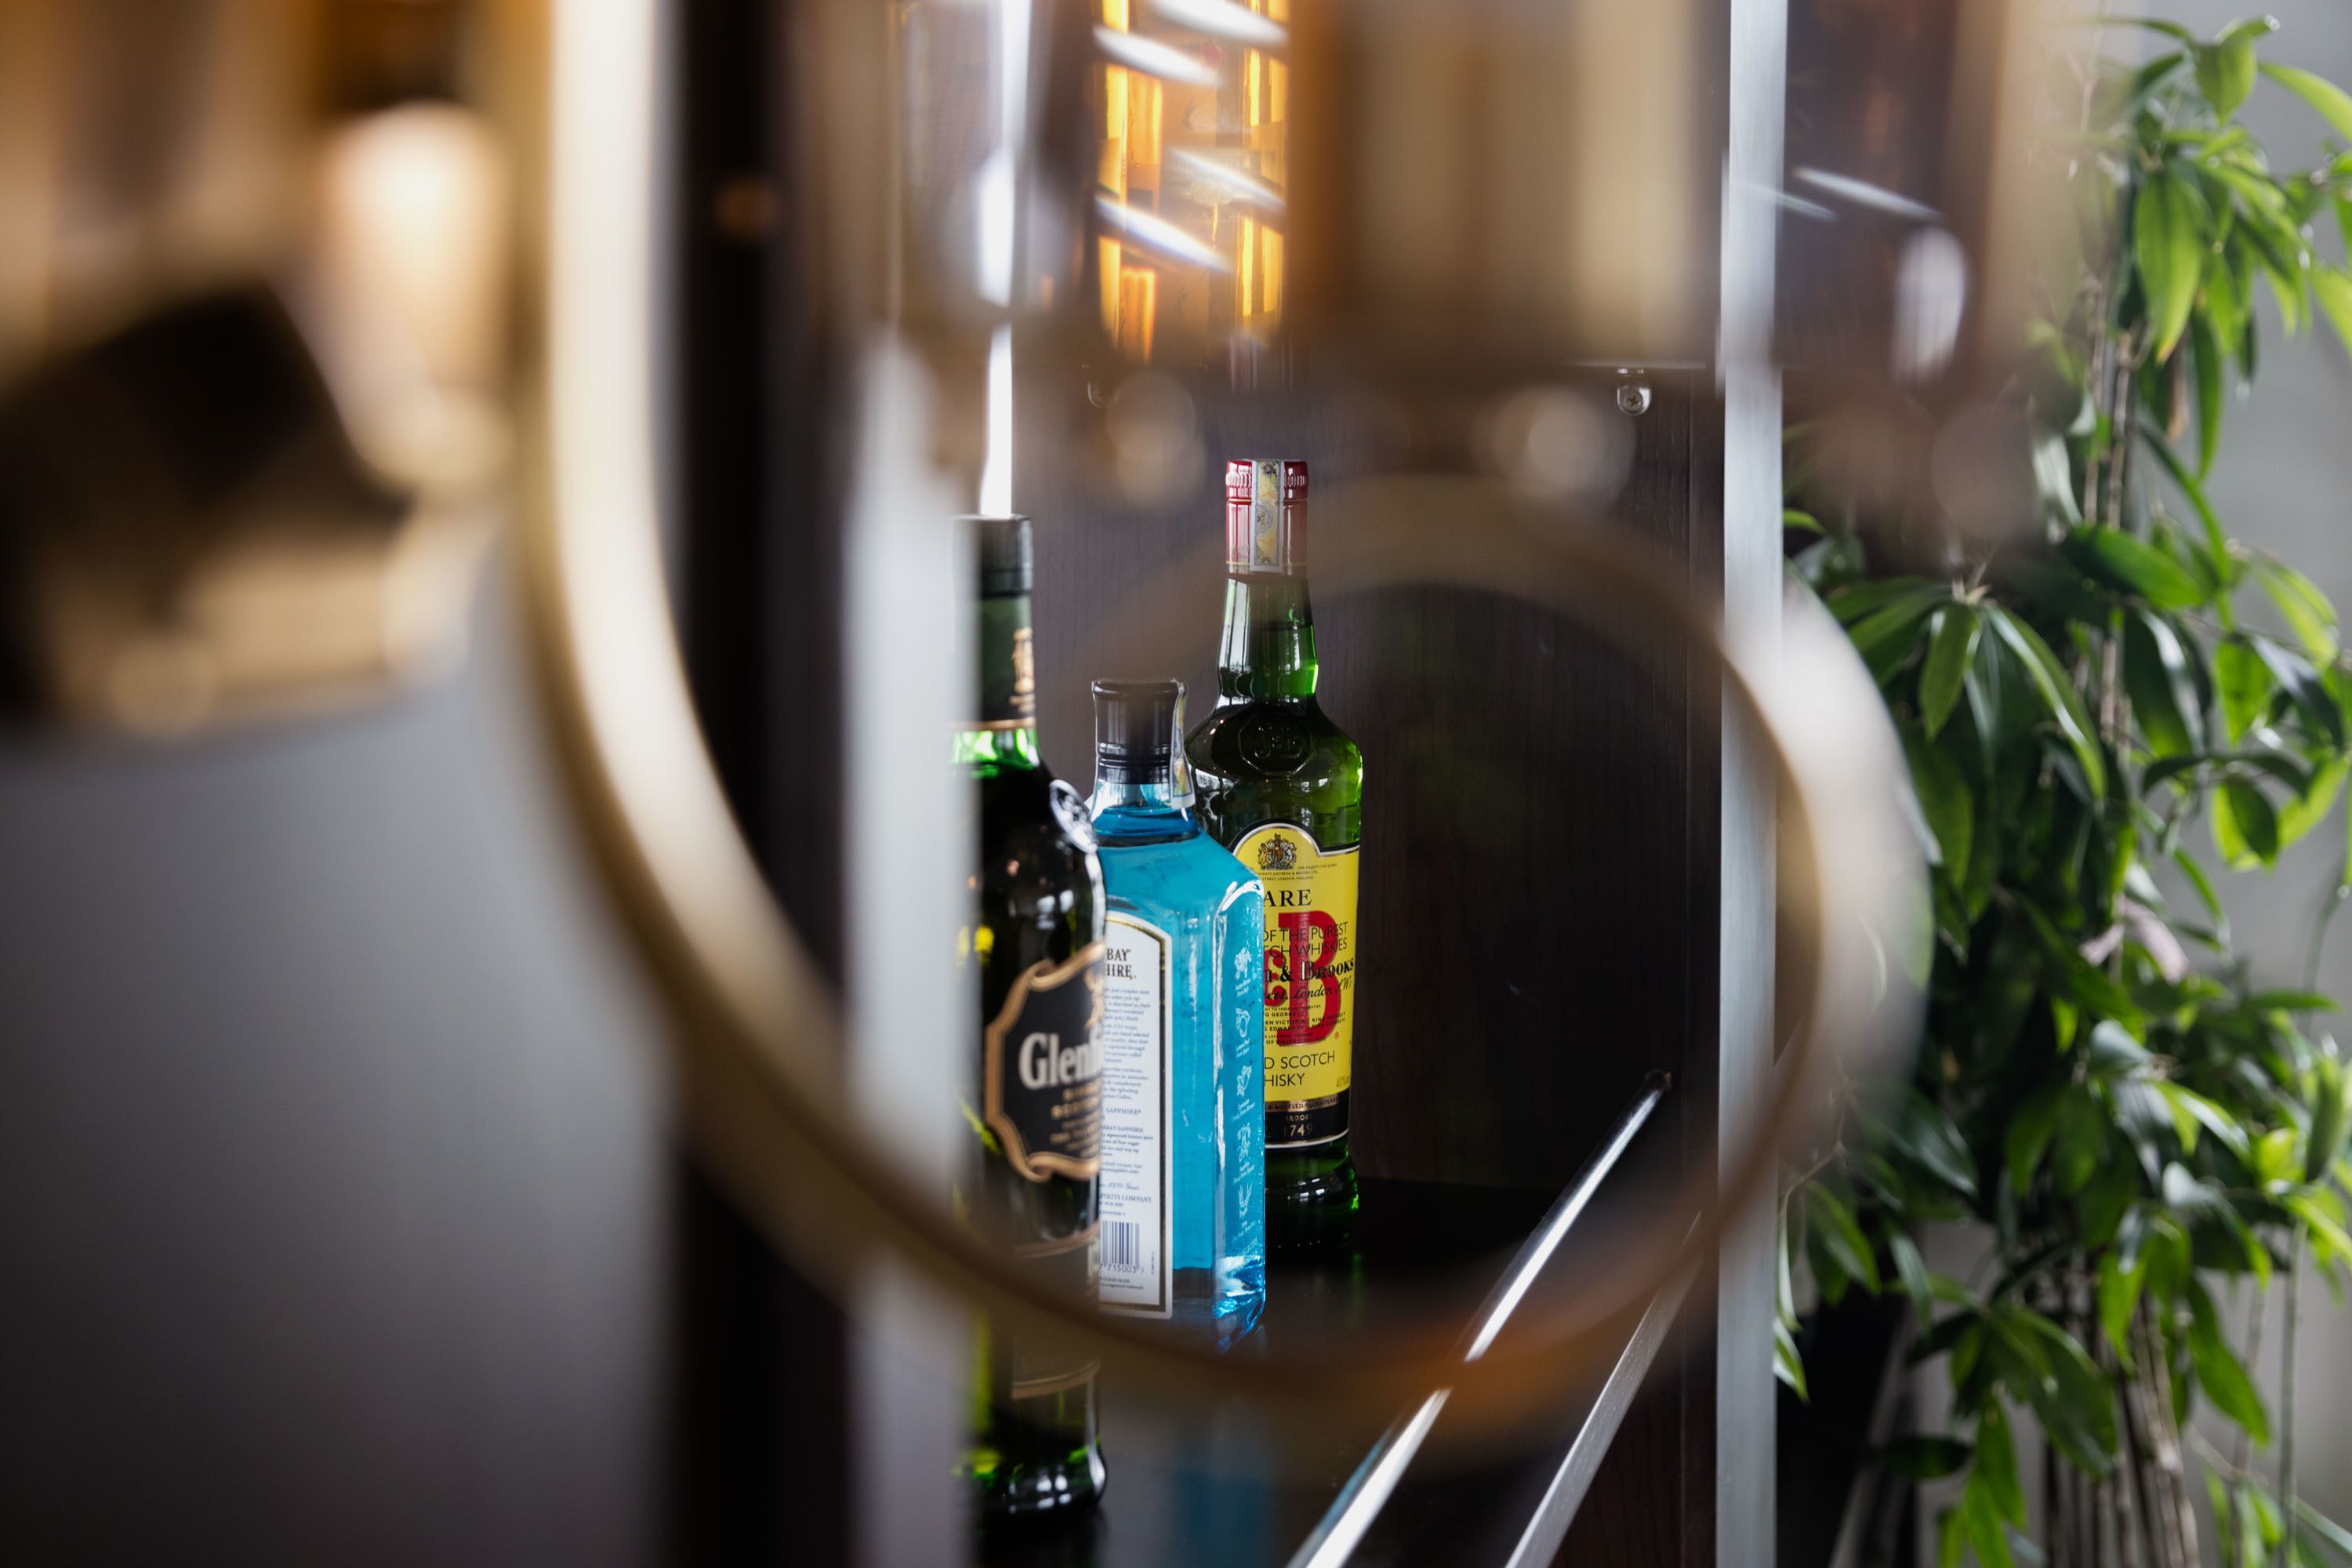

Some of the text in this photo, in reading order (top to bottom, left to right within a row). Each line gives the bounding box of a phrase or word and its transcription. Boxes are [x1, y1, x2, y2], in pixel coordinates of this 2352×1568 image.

[1279, 927, 1308, 942] THE
[1311, 921, 1348, 940] PUREST
[1295, 937, 1347, 956] WHISKIES
[1279, 966, 1293, 982] &
[1293, 984, 1332, 1000] London
[1280, 1051, 1335, 1069] SCOTCH
